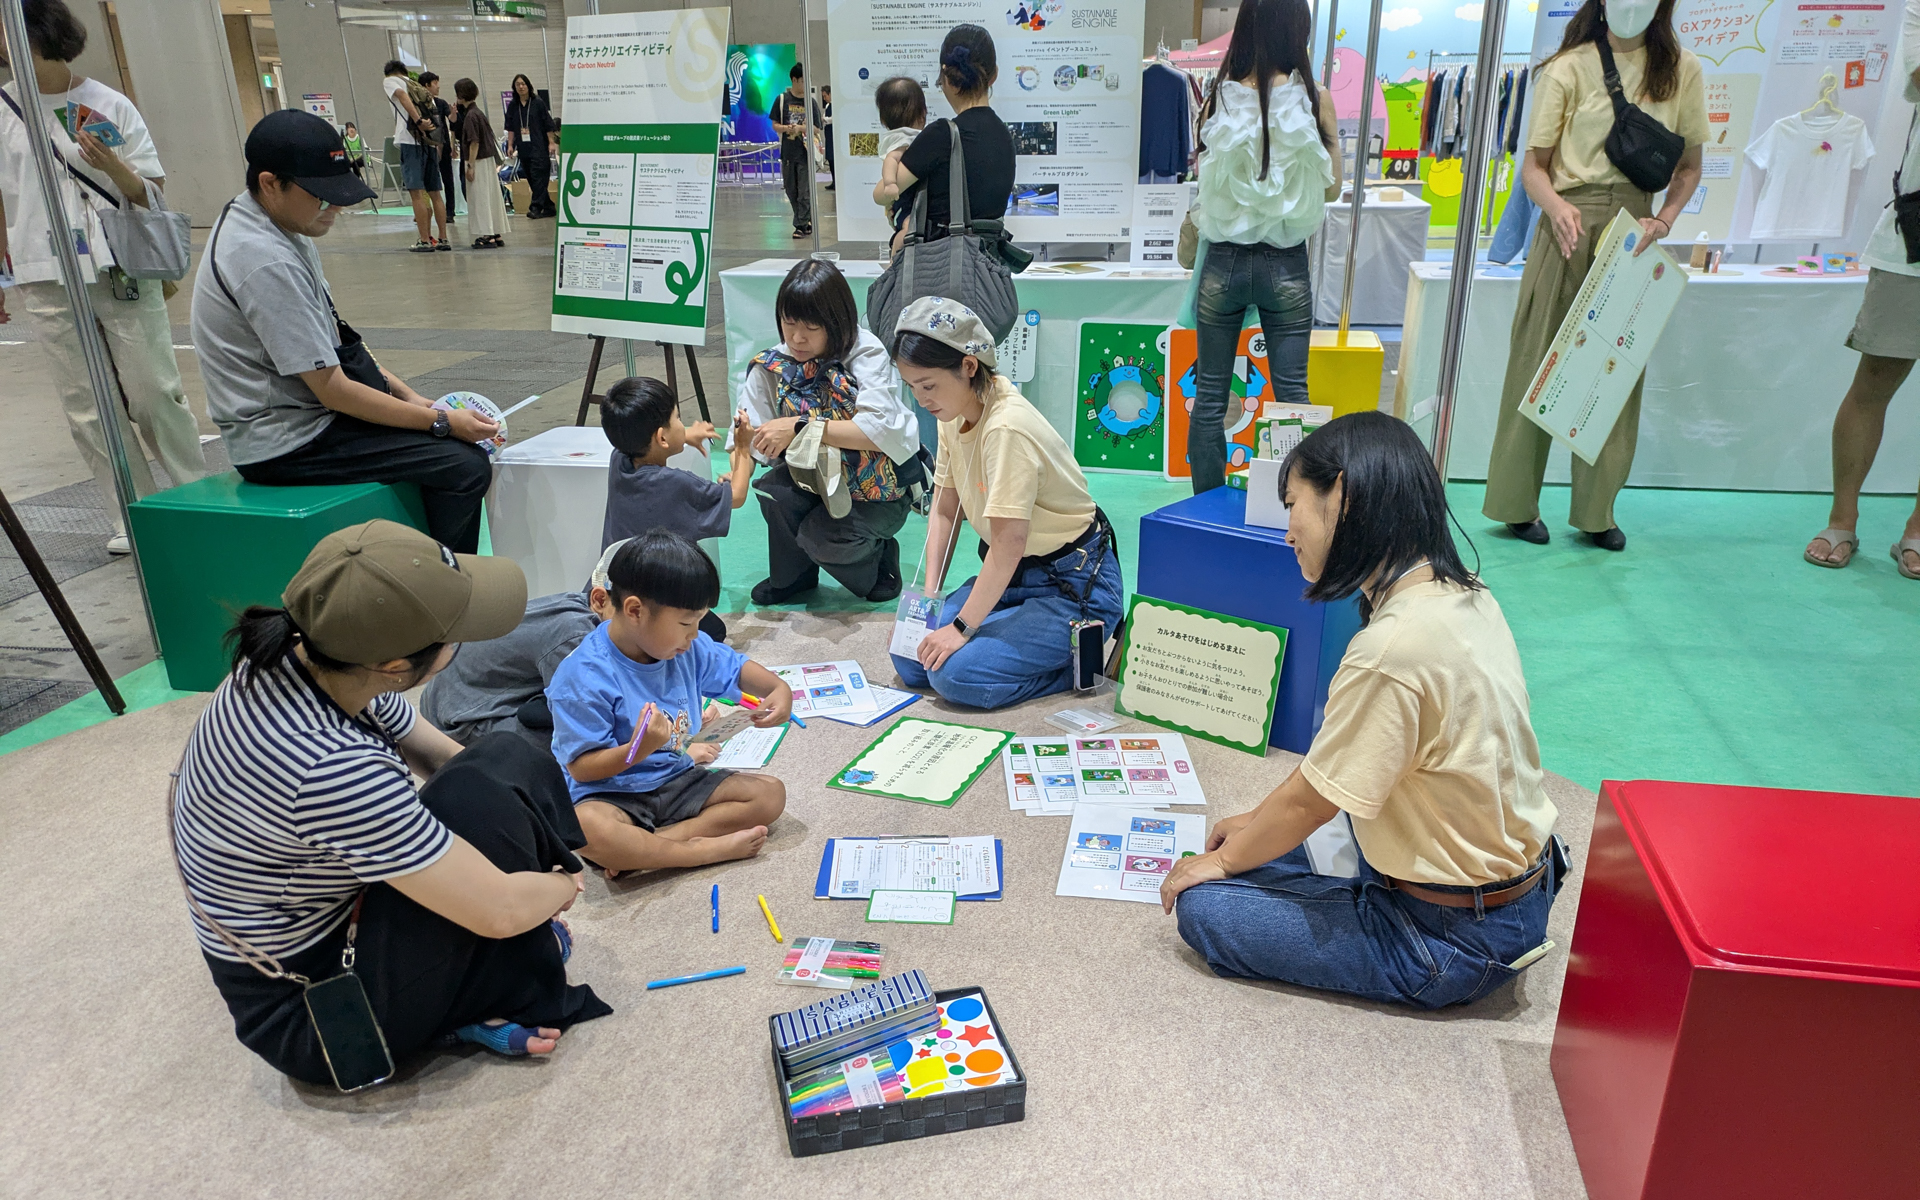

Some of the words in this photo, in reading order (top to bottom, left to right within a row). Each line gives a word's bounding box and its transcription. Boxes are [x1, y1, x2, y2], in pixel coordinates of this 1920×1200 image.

[1071, 9, 1117, 19] SUSTAINABLE
[1680, 14, 1755, 33] GXアクション
[569, 43, 673, 59] サステナクリエイティビティ
[1693, 31, 1740, 48] アイデア
[1028, 313, 1037, 323] は
[1011, 326, 1019, 379] コップに水をくんで
[1254, 339, 1267, 353] あ
[468, 396, 488, 414] EVENT
[908, 605, 925, 614] ART&
[1157, 626, 1246, 656] カルタあそびをはじめるまえに
[1142, 645, 1246, 677] お友だちとぶつからないように気をつけよう。
[1138, 671, 1234, 703] お子さんおひとりでの参加が難しい場合は
[1140, 658, 1265, 697] 小さなお友だちも楽しめるように思いやってあそぼう。
[1135, 683, 1260, 724] 保護者のみなさんがぜひサポートしてあげてください。
[913, 732, 963, 775] 地球温暖化の原因となる
[806, 984, 894, 1020] SABLÉS
